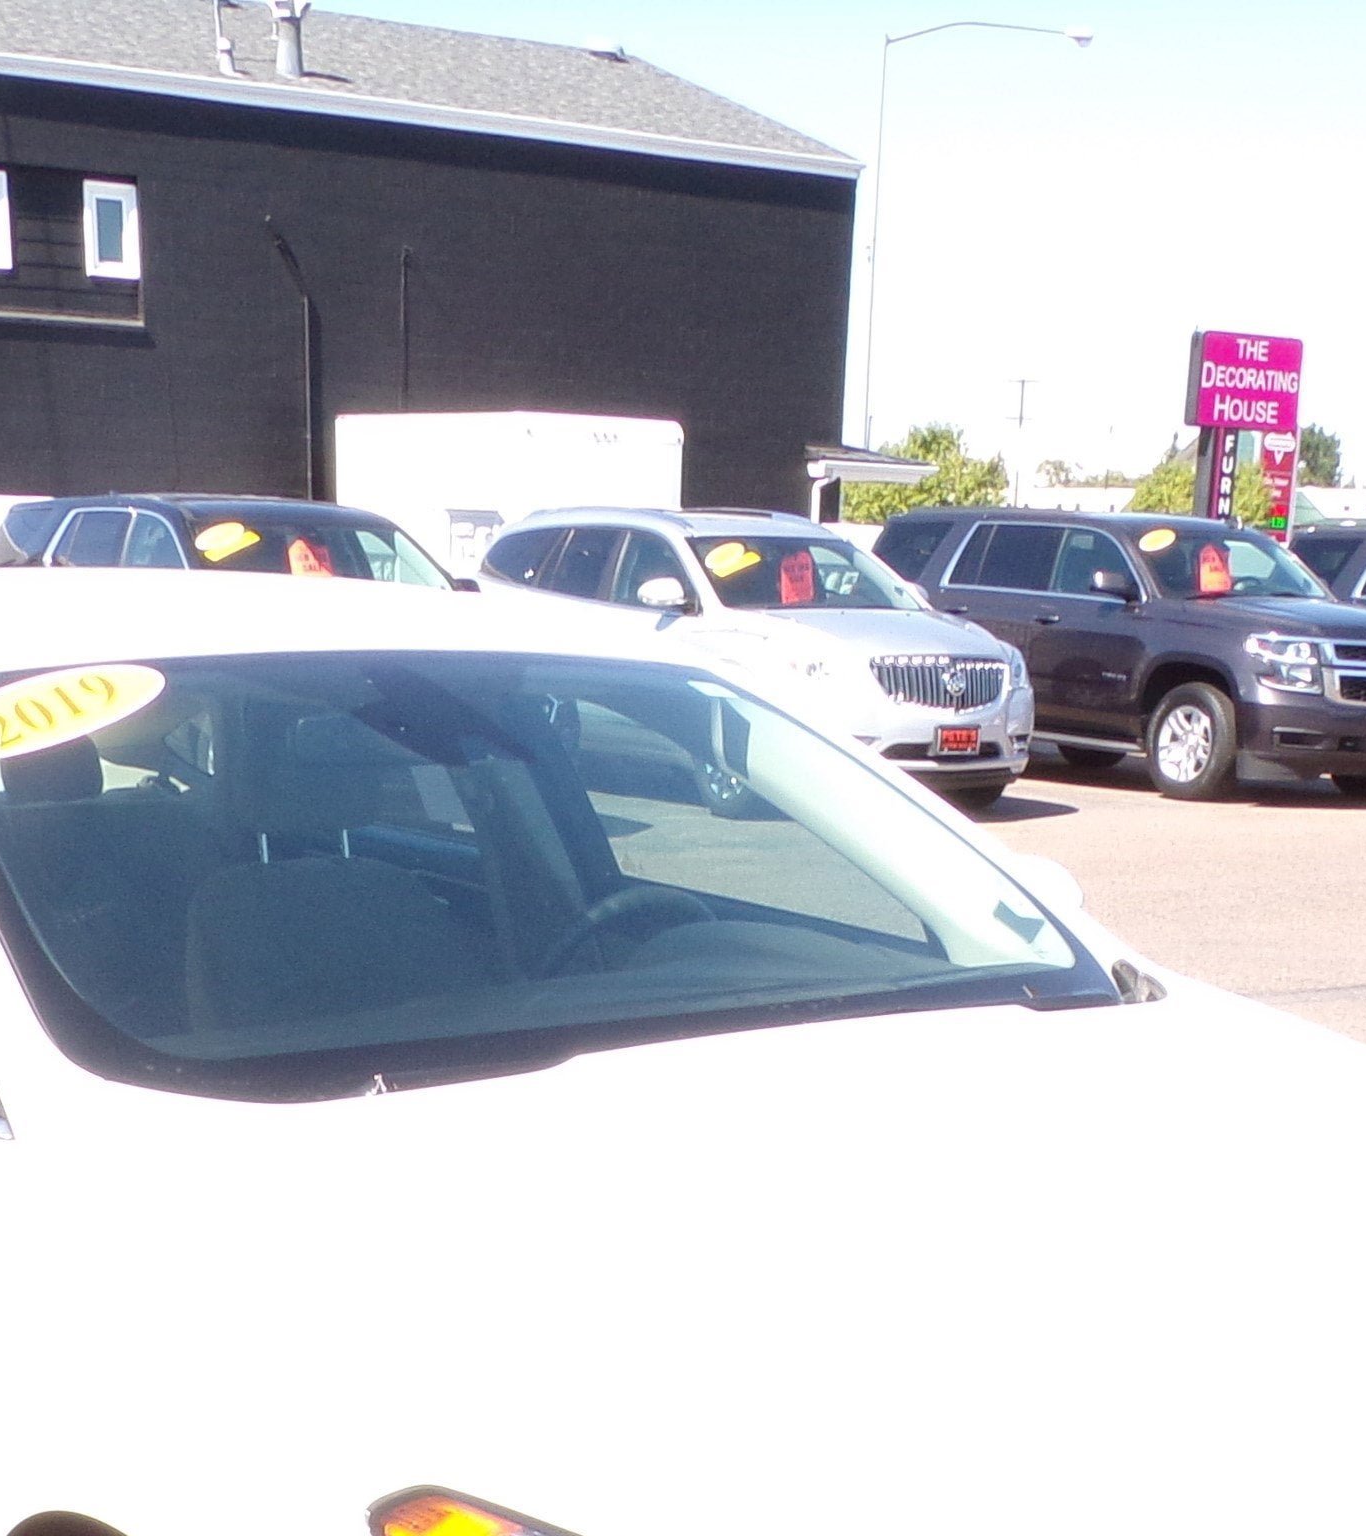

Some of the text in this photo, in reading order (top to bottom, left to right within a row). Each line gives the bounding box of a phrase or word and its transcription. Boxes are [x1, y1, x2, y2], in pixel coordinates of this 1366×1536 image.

[1236, 338, 1270, 363] THE
[1200, 360, 1299, 394] DECORATING
[1213, 393, 1280, 425] HOUSE
